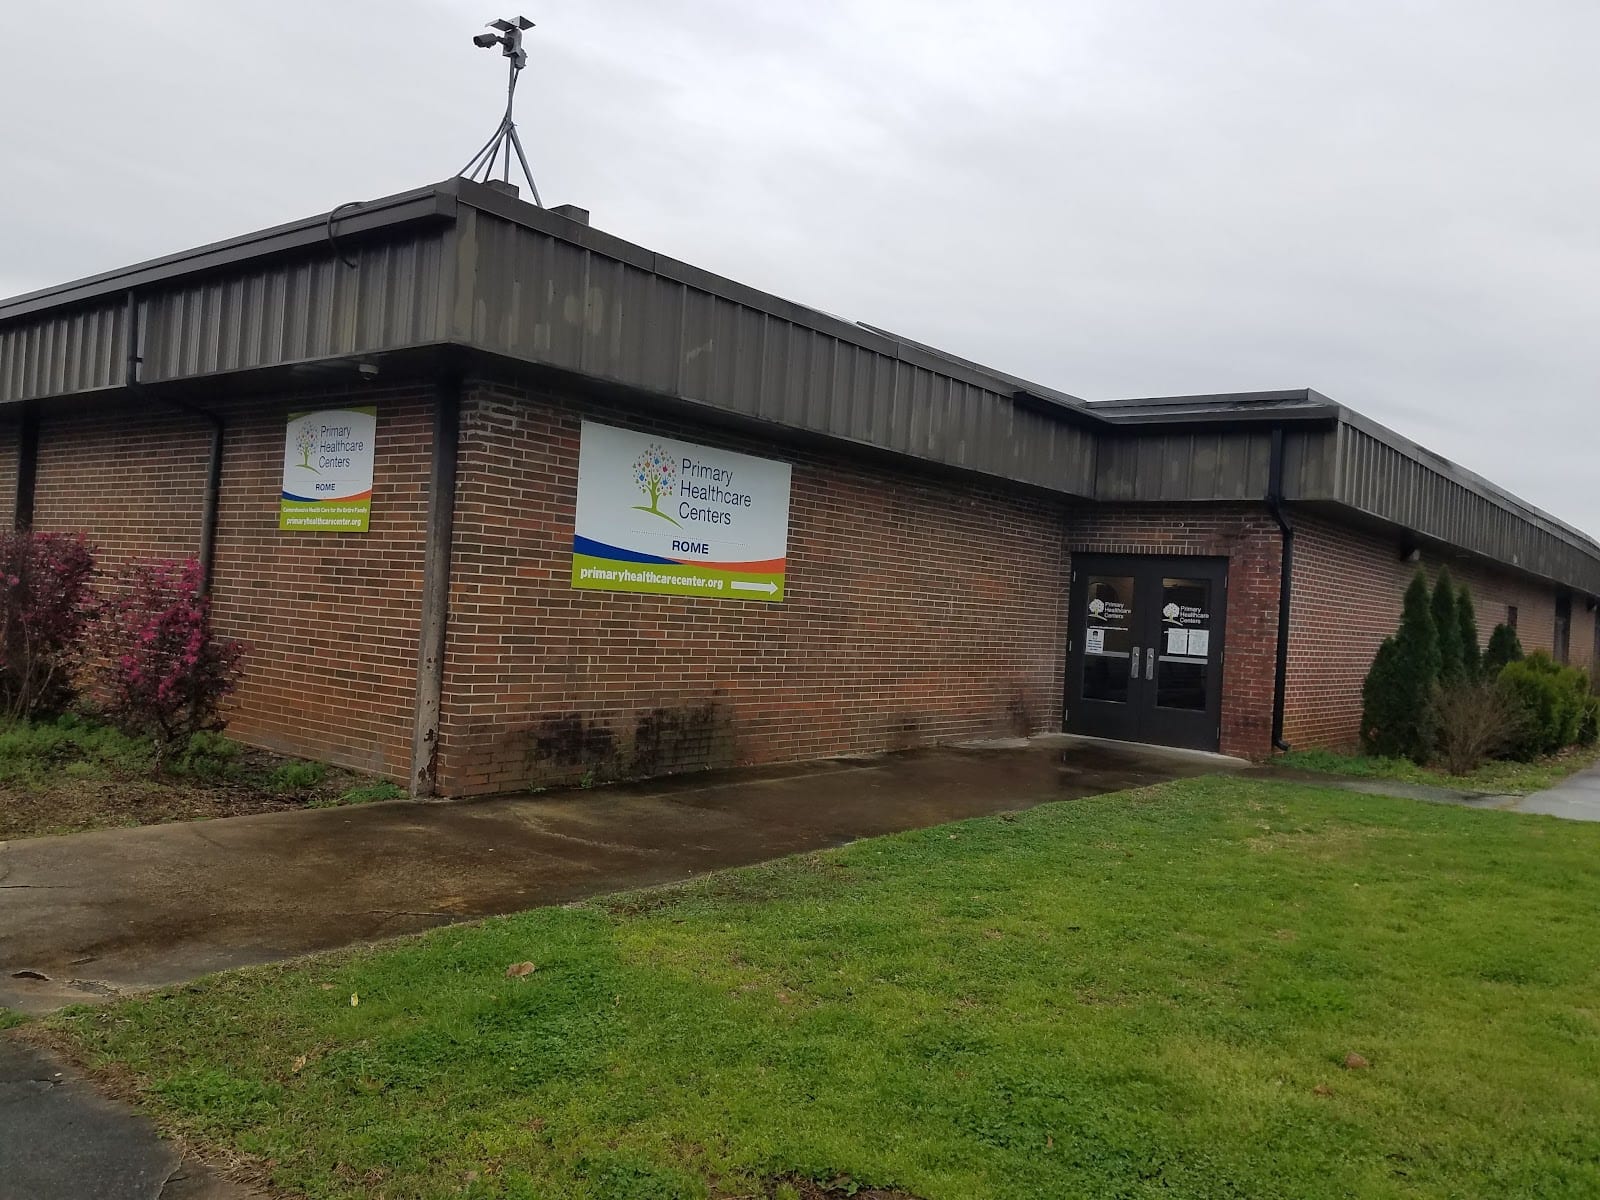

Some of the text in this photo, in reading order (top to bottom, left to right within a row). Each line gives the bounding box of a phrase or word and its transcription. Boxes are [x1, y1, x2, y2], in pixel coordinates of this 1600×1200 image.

[321, 426, 351, 440] Primary
[320, 440, 364, 453] Healthcare
[319, 456, 350, 468] Centers
[681, 458, 733, 487] Primary
[315, 483, 336, 491] ROME
[680, 479, 752, 507] Healthcare
[678, 501, 732, 526] Centers
[286, 517, 362, 527] primaryhealthcarecenter.org
[671, 540, 709, 555] ROME
[580, 566, 724, 590] primaryhealthcarecenter.org
